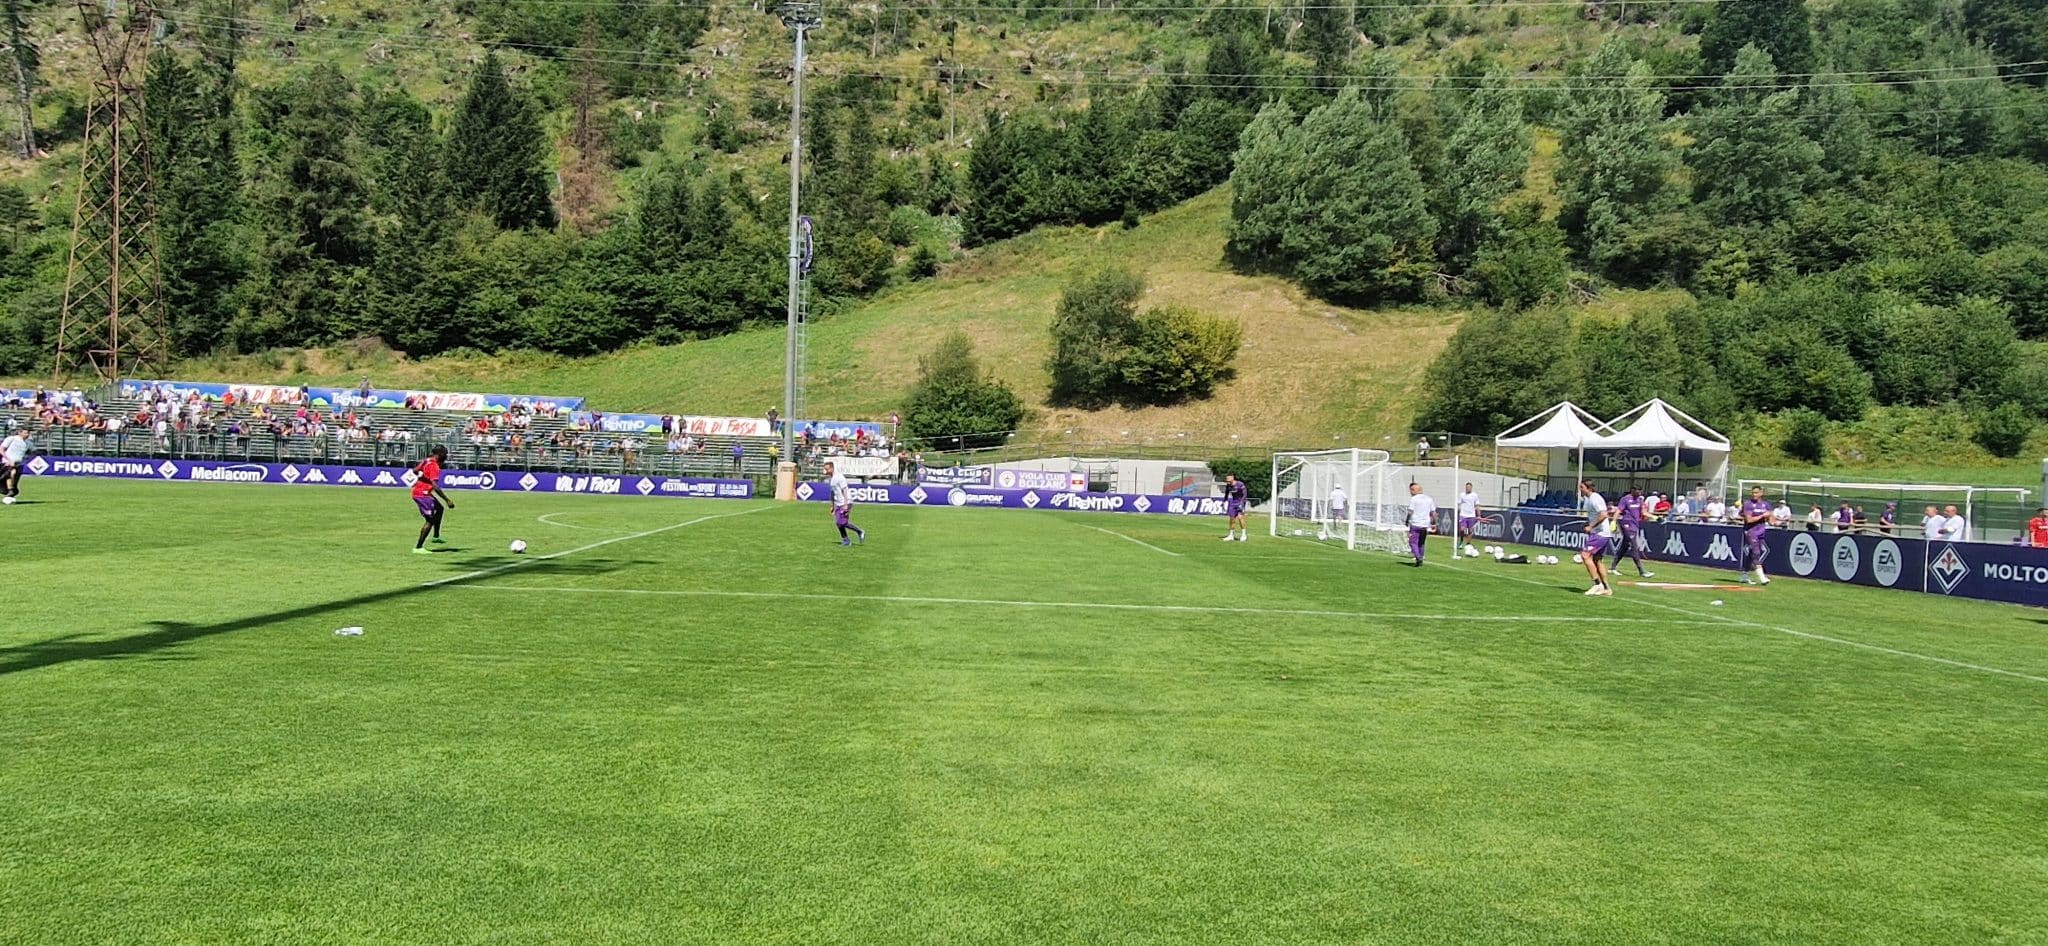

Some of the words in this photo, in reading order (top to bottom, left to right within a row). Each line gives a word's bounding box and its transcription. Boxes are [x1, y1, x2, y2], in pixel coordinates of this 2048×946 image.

[690, 419, 706, 433] VAL
[711, 420, 722, 432] DI
[727, 419, 758, 435] FASSA
[53, 461, 154, 475] FIORENTINA
[1602, 453, 1662, 470] TRENTINO
[191, 466, 262, 481] Mediacom
[1045, 472, 1066, 481] CLUB
[555, 475, 574, 491] VAL
[574, 476, 590, 491] DI
[590, 476, 621, 493] FASSA
[1066, 492, 1124, 511] TRENTINO
[1167, 498, 1185, 513] VAL
[1184, 499, 1200, 515] DI
[1794, 542, 1812, 556] EA
[1837, 546, 1854, 560] EA
[1793, 556, 1813, 565] SPORTS
[1836, 561, 1855, 569] SPORTS
[1878, 550, 1896, 565] EA
[1877, 565, 1897, 574] SPORTS
[1984, 562, 2048, 584] MOLTO
